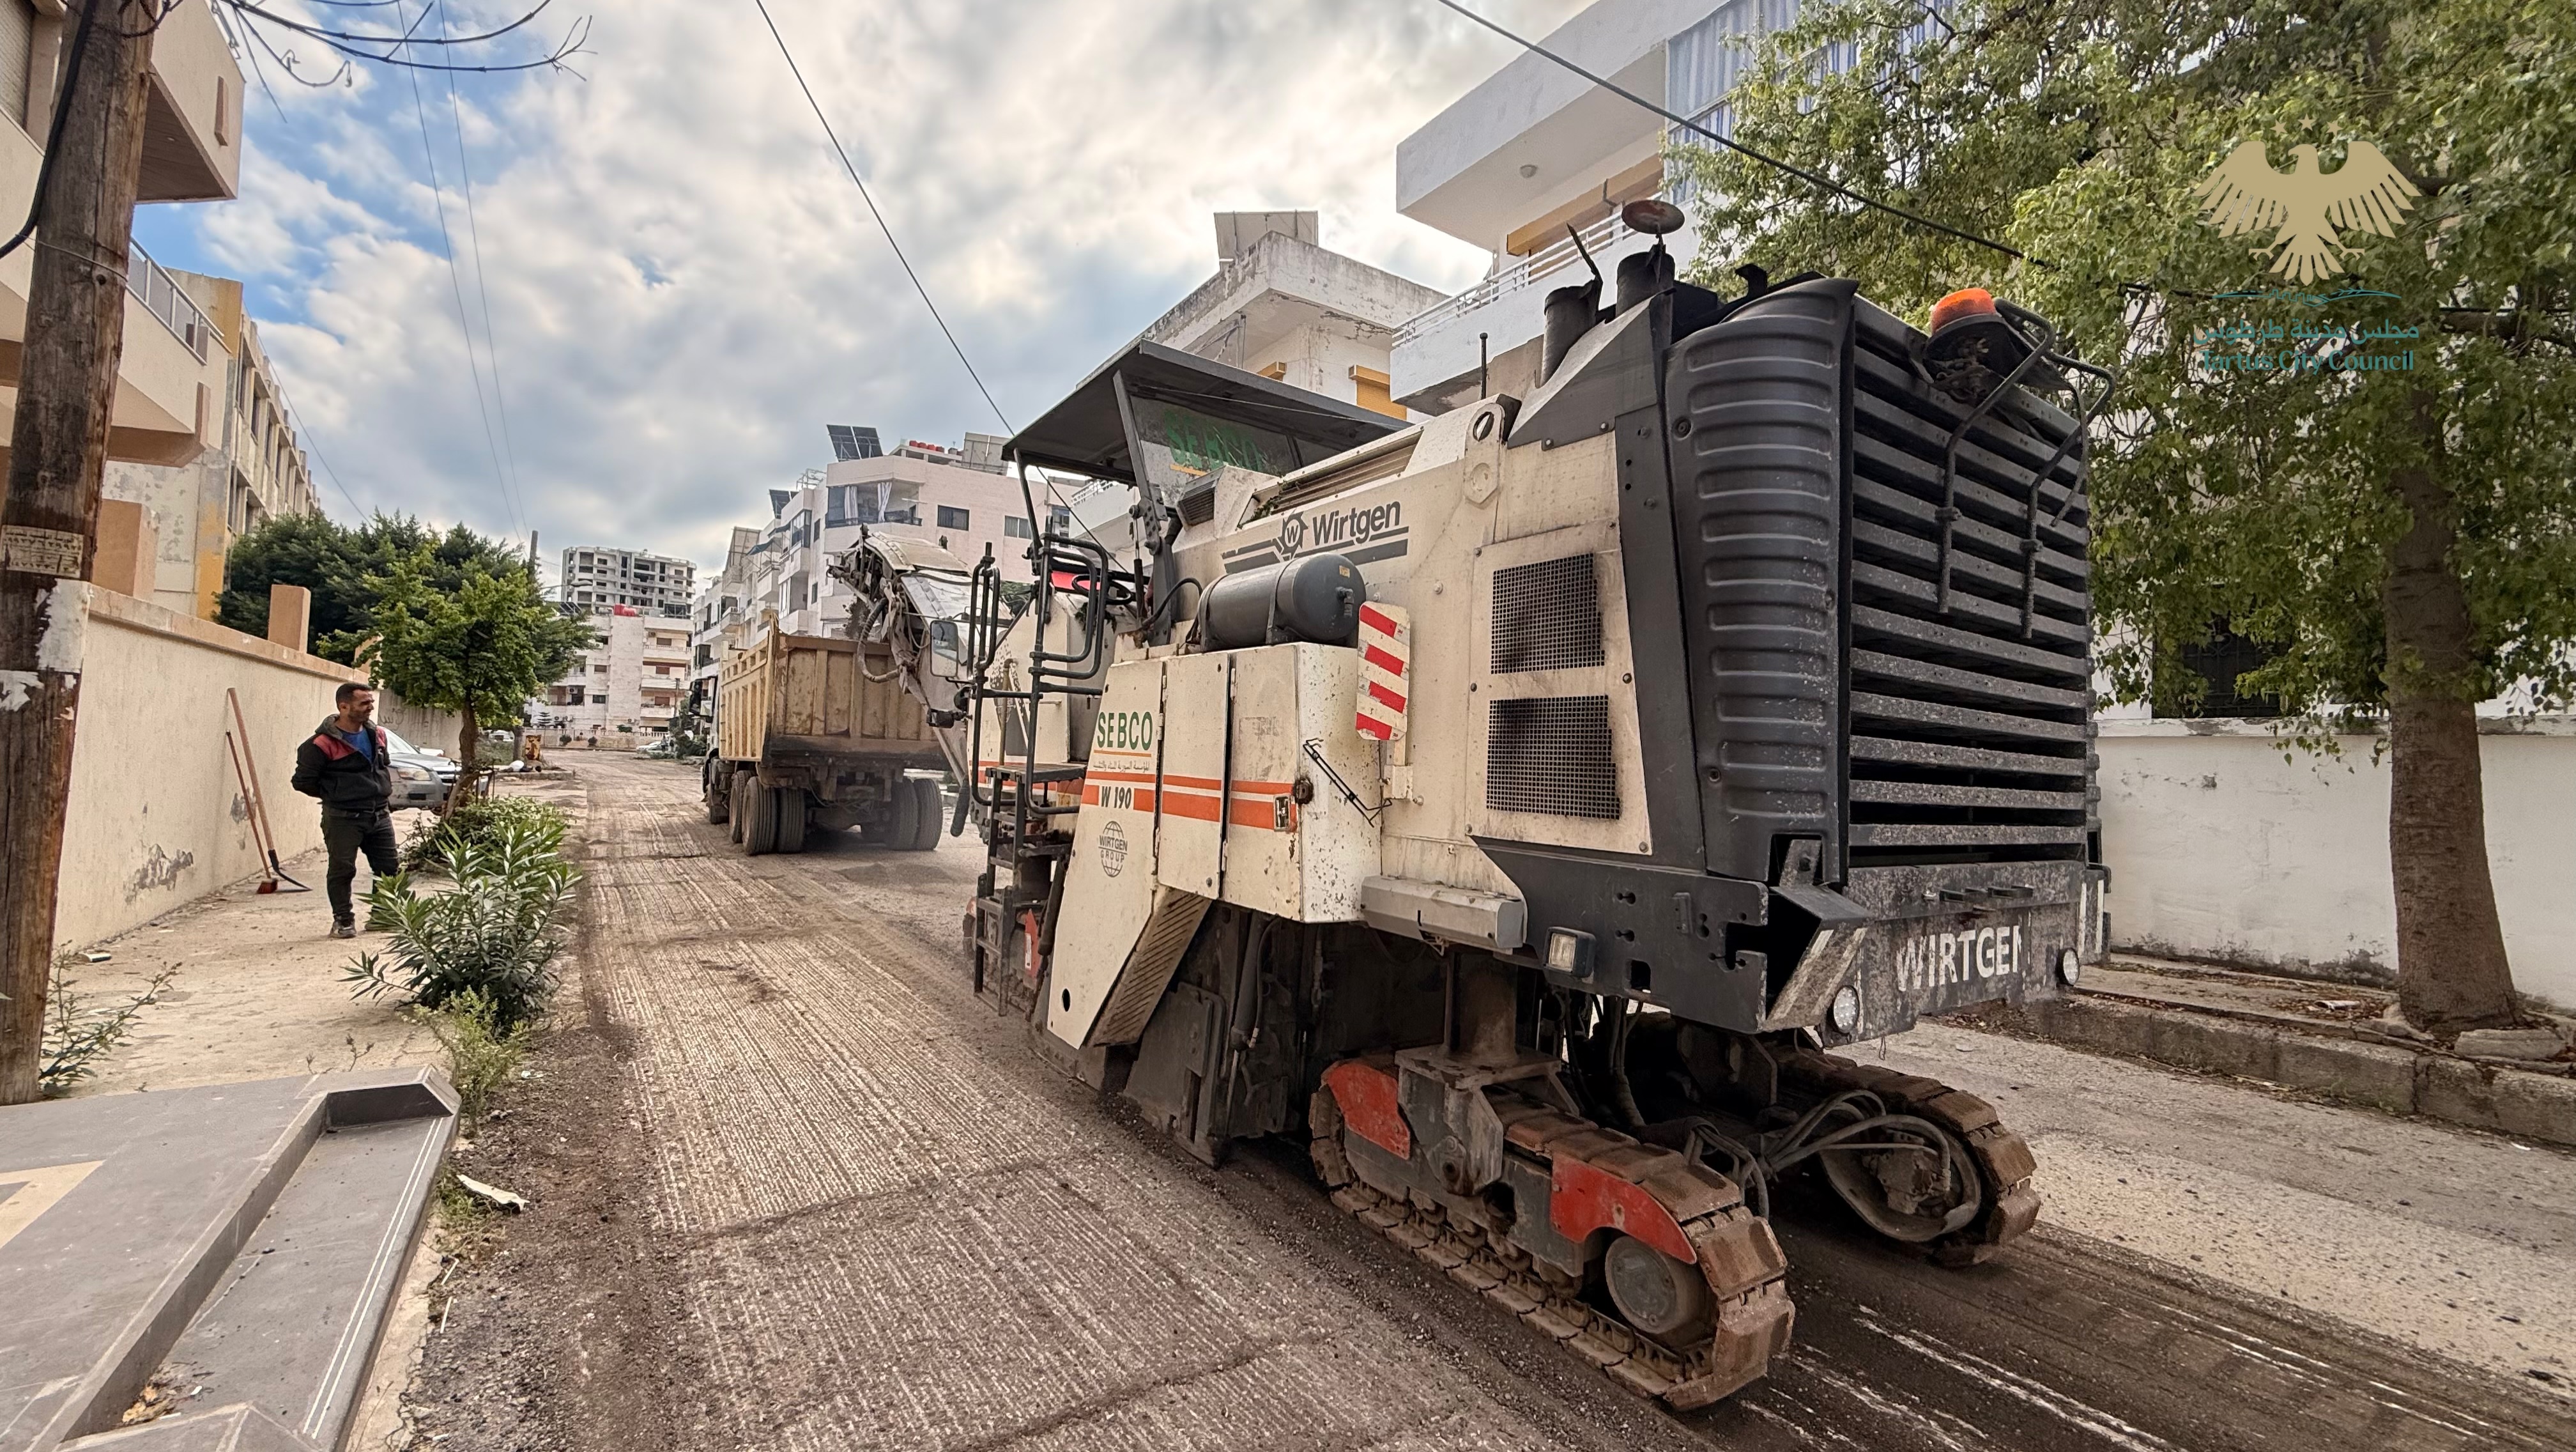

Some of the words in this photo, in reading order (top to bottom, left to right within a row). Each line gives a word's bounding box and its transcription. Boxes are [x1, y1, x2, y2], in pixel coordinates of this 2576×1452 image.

[1312, 501, 1401, 546] Wirtgen
[1097, 711, 1153, 751] SEBCO
[1101, 785, 1112, 808] W
[1114, 785, 1132, 810] 190
[1099, 835, 1128, 852] WIRTGEN
[1100, 849, 1125, 863] GROUP
